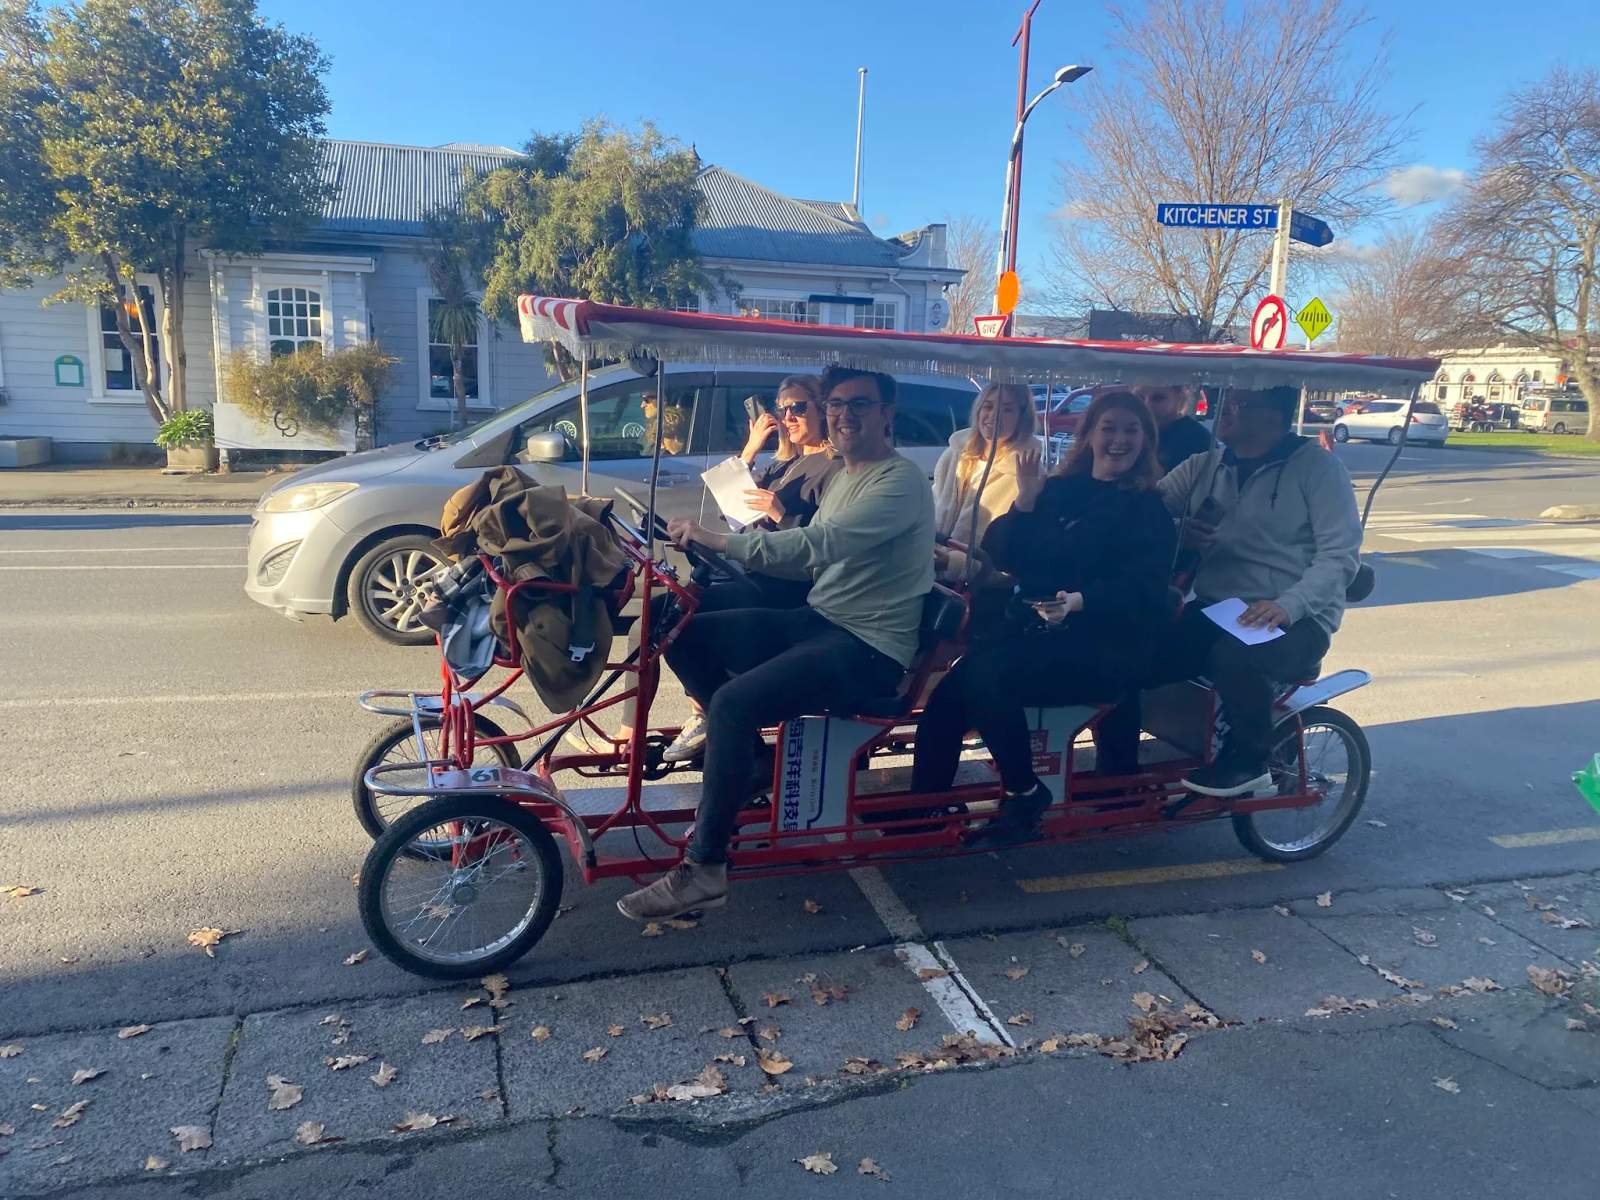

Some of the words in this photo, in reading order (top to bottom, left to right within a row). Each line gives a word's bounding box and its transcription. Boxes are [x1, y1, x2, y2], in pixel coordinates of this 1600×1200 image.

[1163, 206, 1248, 226] KITCHENER
[1252, 208, 1273, 225] ST
[982, 323, 997, 335] GIVE
[471, 769, 501, 783] 61
